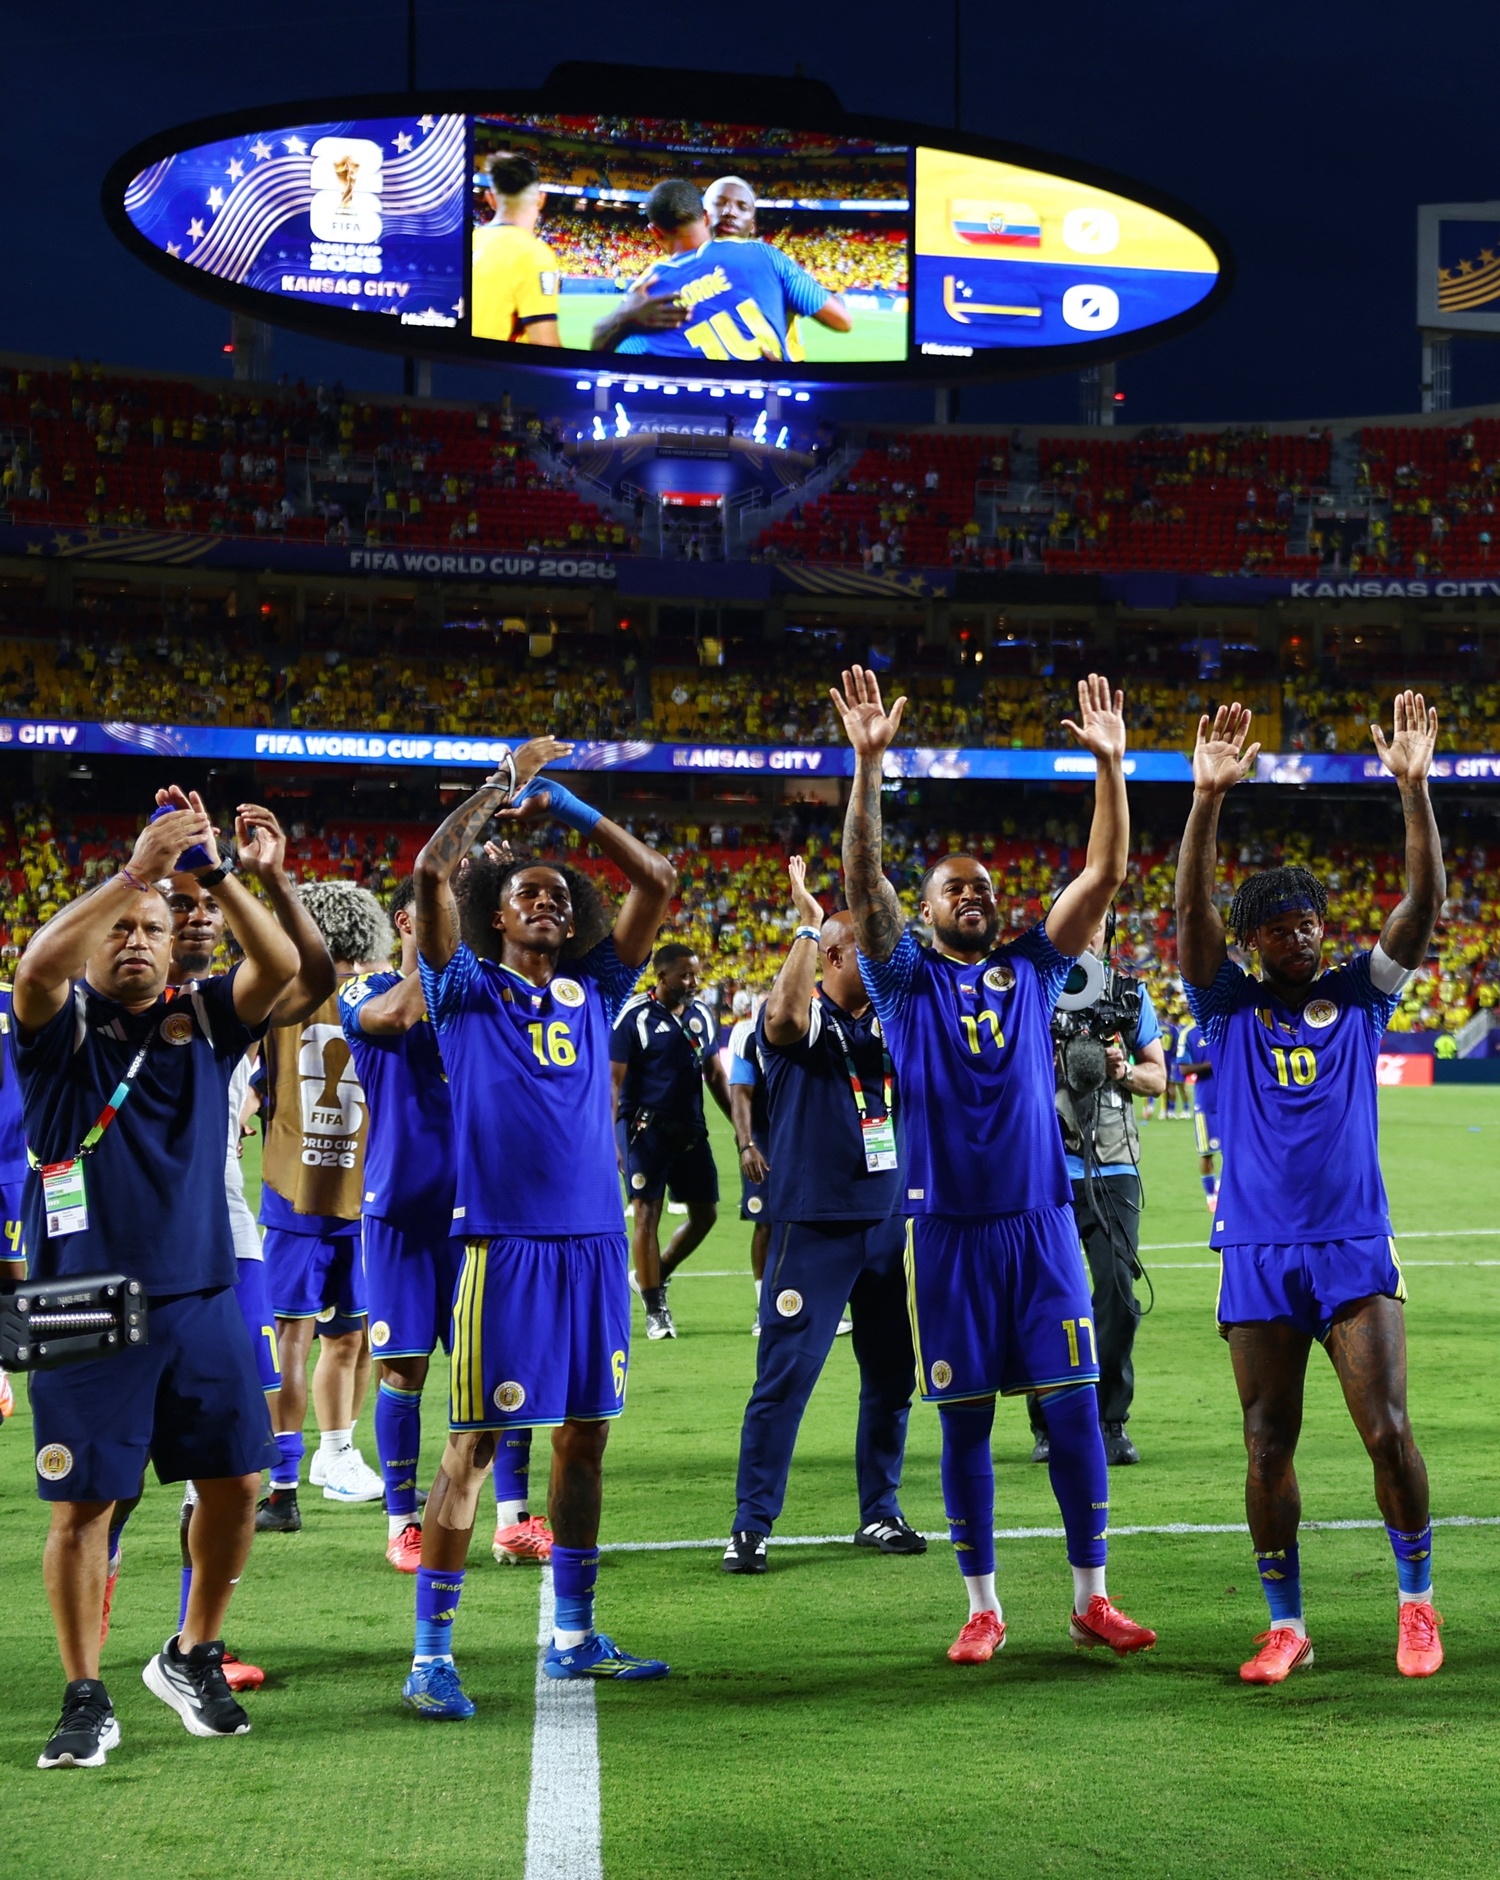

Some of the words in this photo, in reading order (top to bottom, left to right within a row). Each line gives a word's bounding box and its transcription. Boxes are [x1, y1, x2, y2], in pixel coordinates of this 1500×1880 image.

[1062, 208, 1120, 254] 0
[310, 242, 355, 256] WORLD
[355, 244, 383, 258] CUP
[310, 255, 383, 275] 2026
[281, 275, 362, 295] KANSAS
[364, 280, 411, 297] CITY
[1062, 284, 1120, 332] 0
[350, 551, 398, 570] FIFA
[403, 555, 485, 574] WORLD
[489, 557, 535, 576] CUP
[538, 560, 617, 579] 2026
[1291, 582, 1428, 597] KANSAS
[19, 724, 78, 745] CITY
[256, 735, 304, 755] FIFA
[305, 736, 385, 758] WORLD
[387, 739, 432, 759] CUP
[433, 741, 508, 762] 2026
[673, 749, 765, 768] KANSAS
[769, 750, 822, 770] CITY
[961, 1009, 1005, 1054] 17
[528, 1020, 577, 1066] 16
[126, 1056, 143, 1078] 2026
[1271, 1047, 1317, 1086] 10
[311, 1112, 343, 1126] FIFA
[334, 1138, 359, 1152] CUP
[301, 1149, 356, 1169] 026
[5, 1220, 22, 1252] 4
